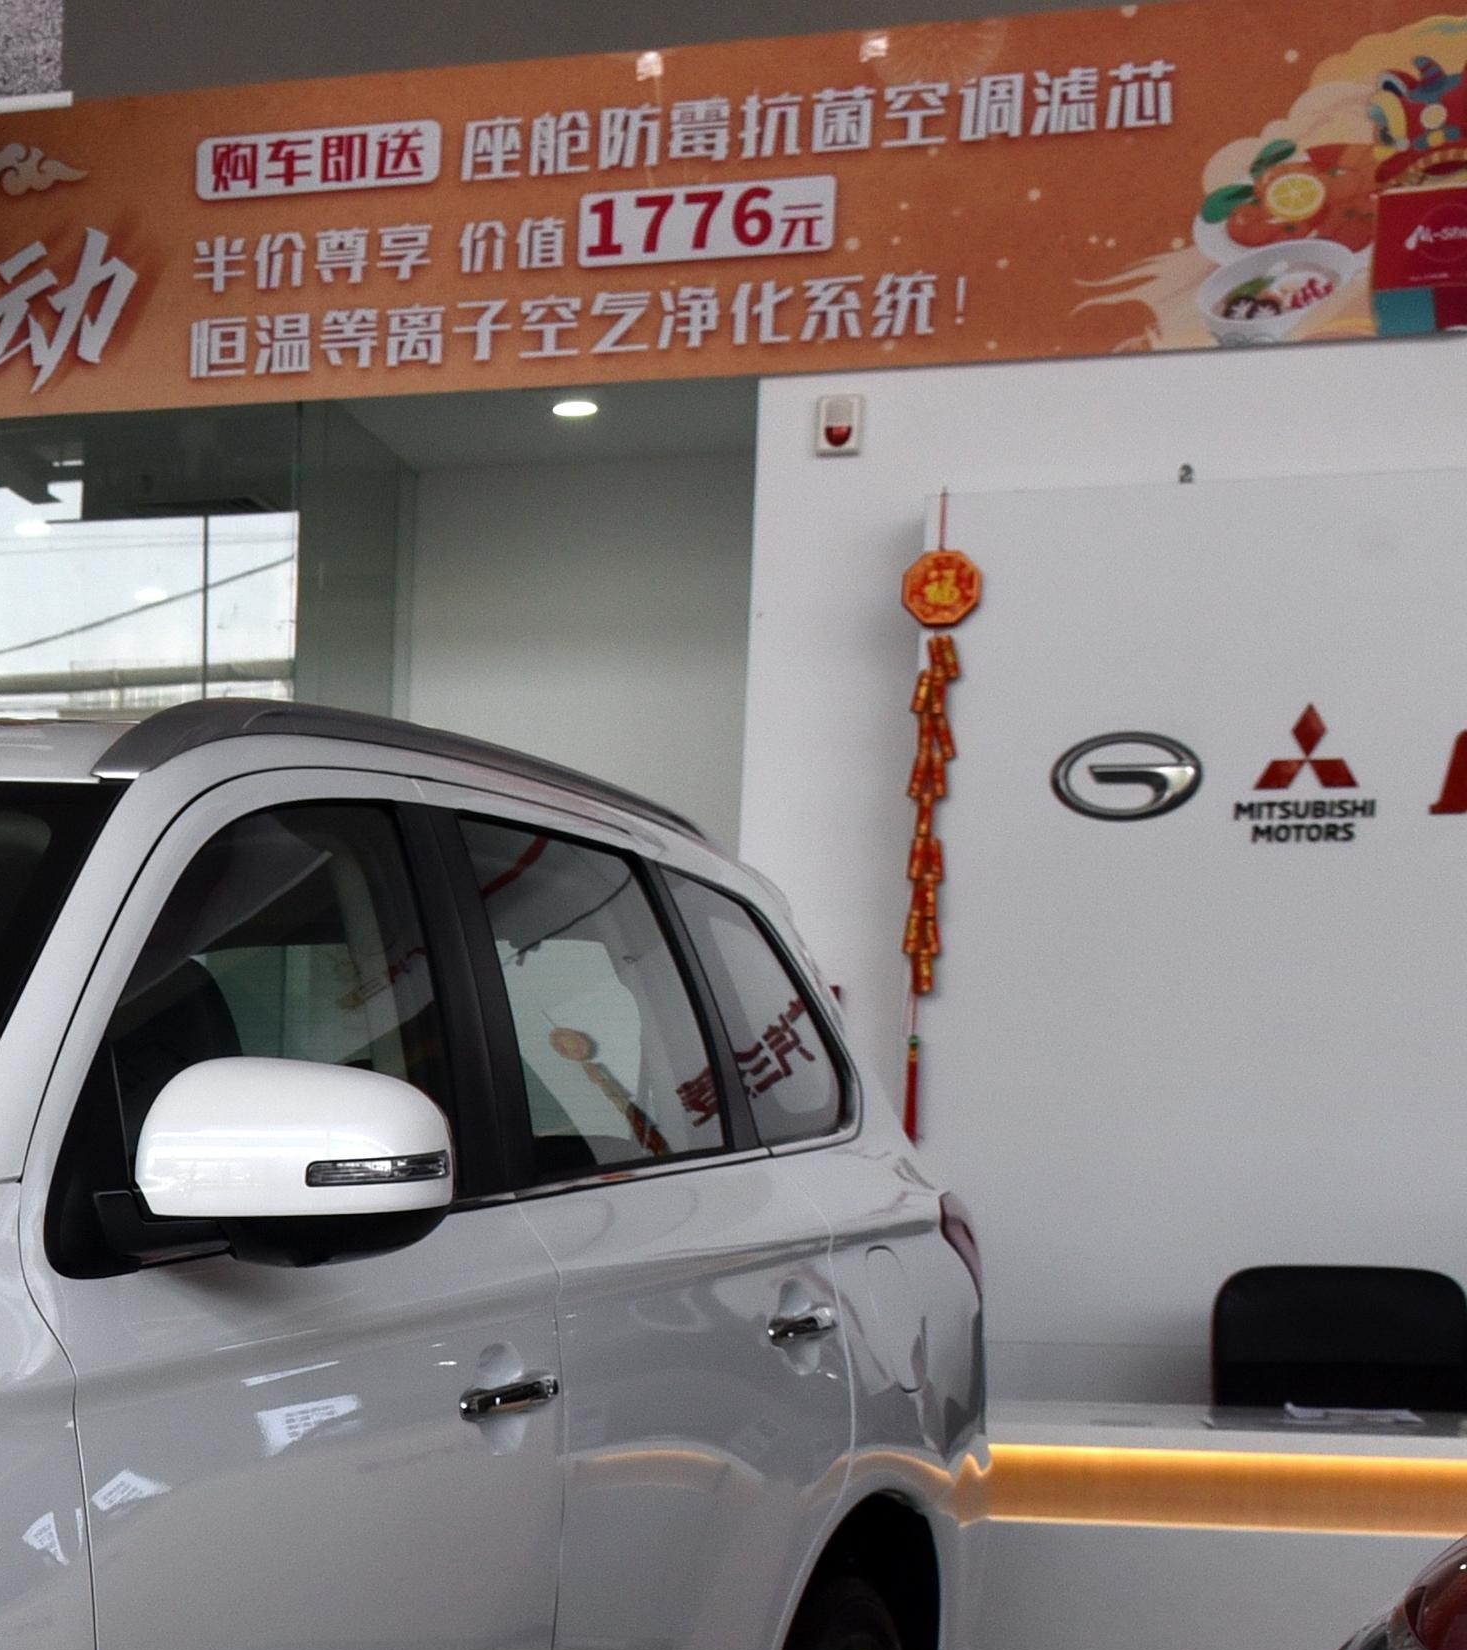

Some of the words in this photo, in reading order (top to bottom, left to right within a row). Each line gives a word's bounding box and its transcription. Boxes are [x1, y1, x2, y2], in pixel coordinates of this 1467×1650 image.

[212, 129, 424, 192] 购车即送
[461, 59, 1175, 181] 座舱防霉抗菌空调滤芯
[193, 223, 432, 293] 半价尊享
[460, 215, 566, 274] 价值
[587, 186, 823, 258] 1776元
[190, 270, 966, 379] 恒温等离子空气净化系统！
[1234, 798, 1376, 822] MITSUBISHI
[1252, 822, 1355, 843] MOTORS
